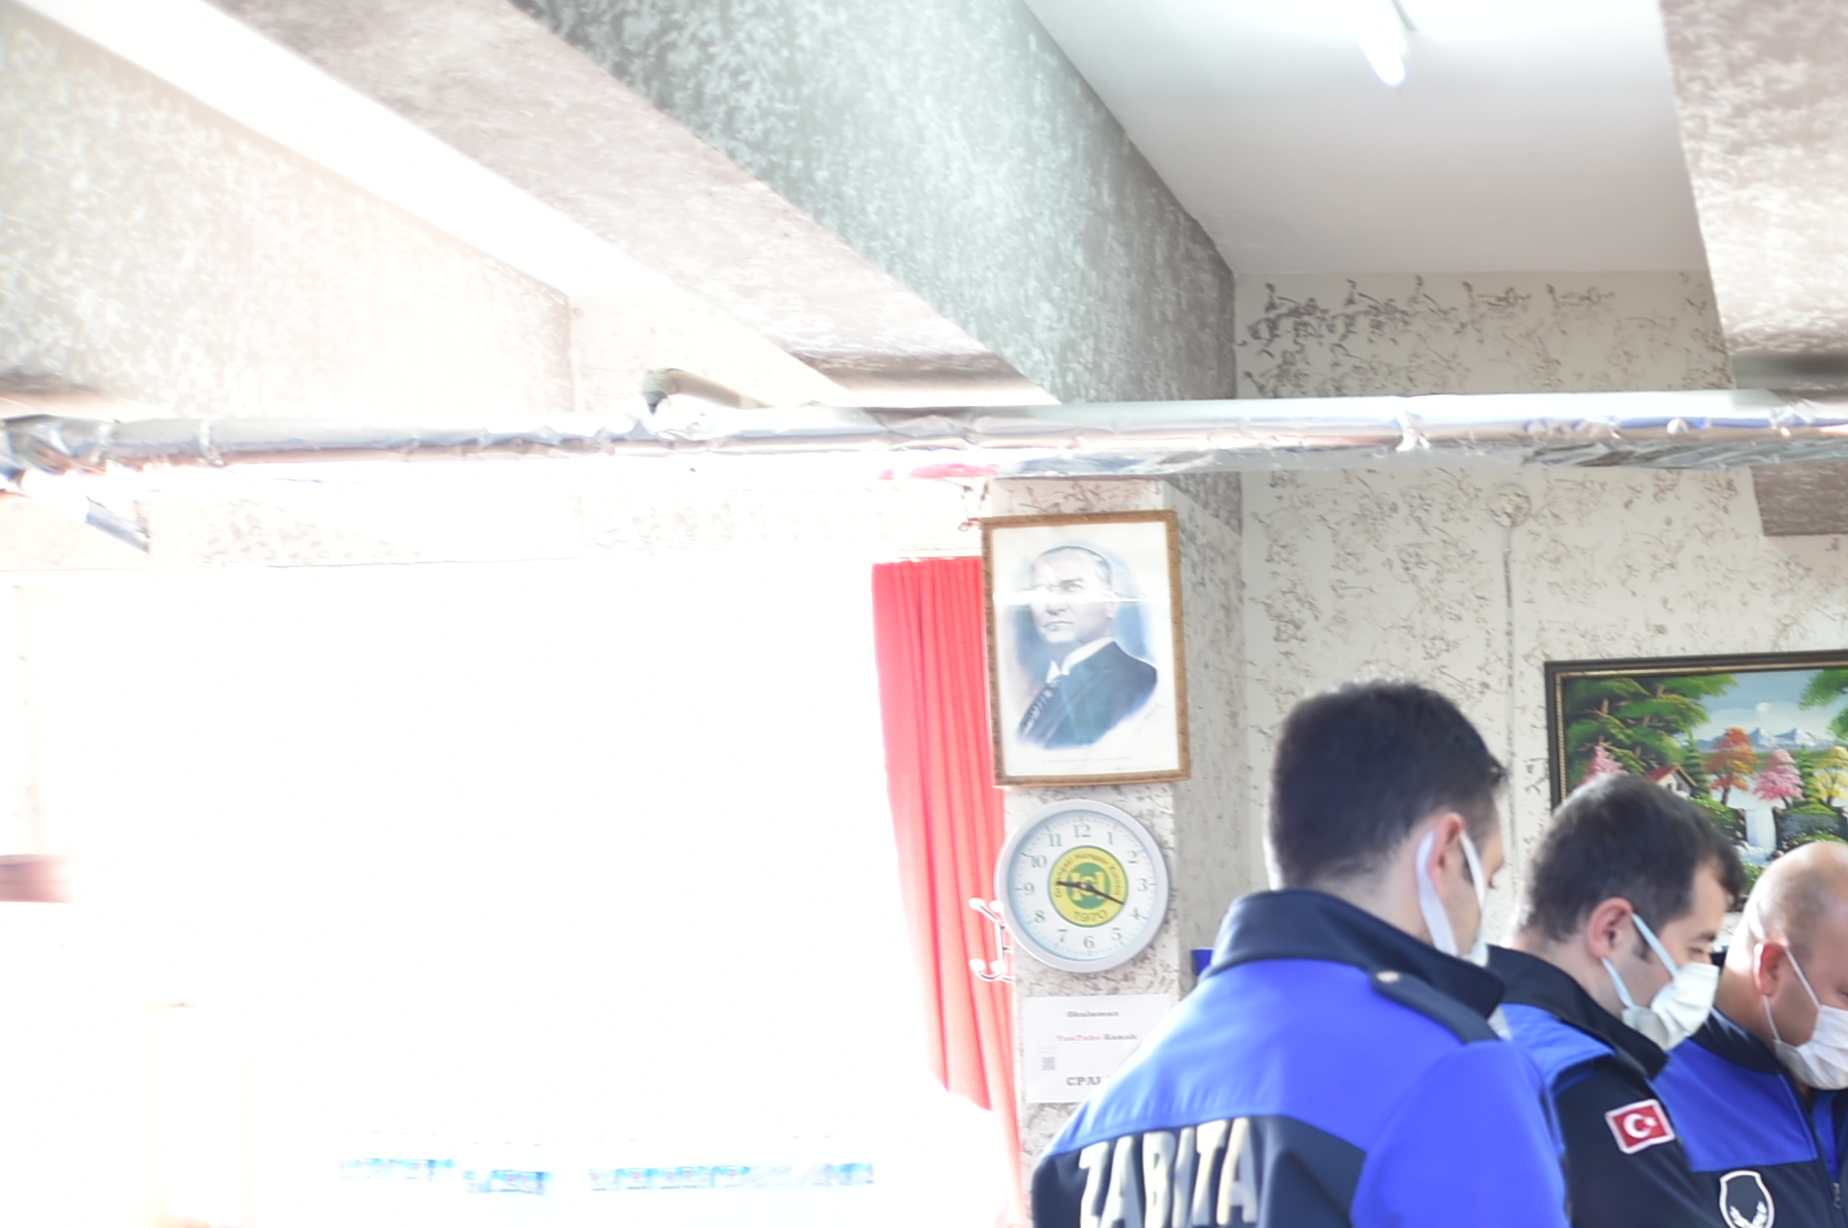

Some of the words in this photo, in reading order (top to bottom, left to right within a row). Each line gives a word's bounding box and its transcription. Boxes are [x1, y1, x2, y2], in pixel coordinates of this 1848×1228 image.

[1073, 824, 1091, 838] 12
[1049, 834, 1062, 847] 11
[1107, 832, 1114, 845] 1
[1031, 855, 1047, 868] 10
[1128, 850, 1138, 864] 2
[1023, 882, 1035, 896] 9
[1137, 878, 1148, 892] 3
[1034, 909, 1046, 923] 8
[1073, 909, 1108, 922] 1970
[1130, 907, 1141, 920] 4
[1057, 929, 1068, 943] 7
[1111, 927, 1122, 941] 5
[1083, 935, 1095, 949] 6
